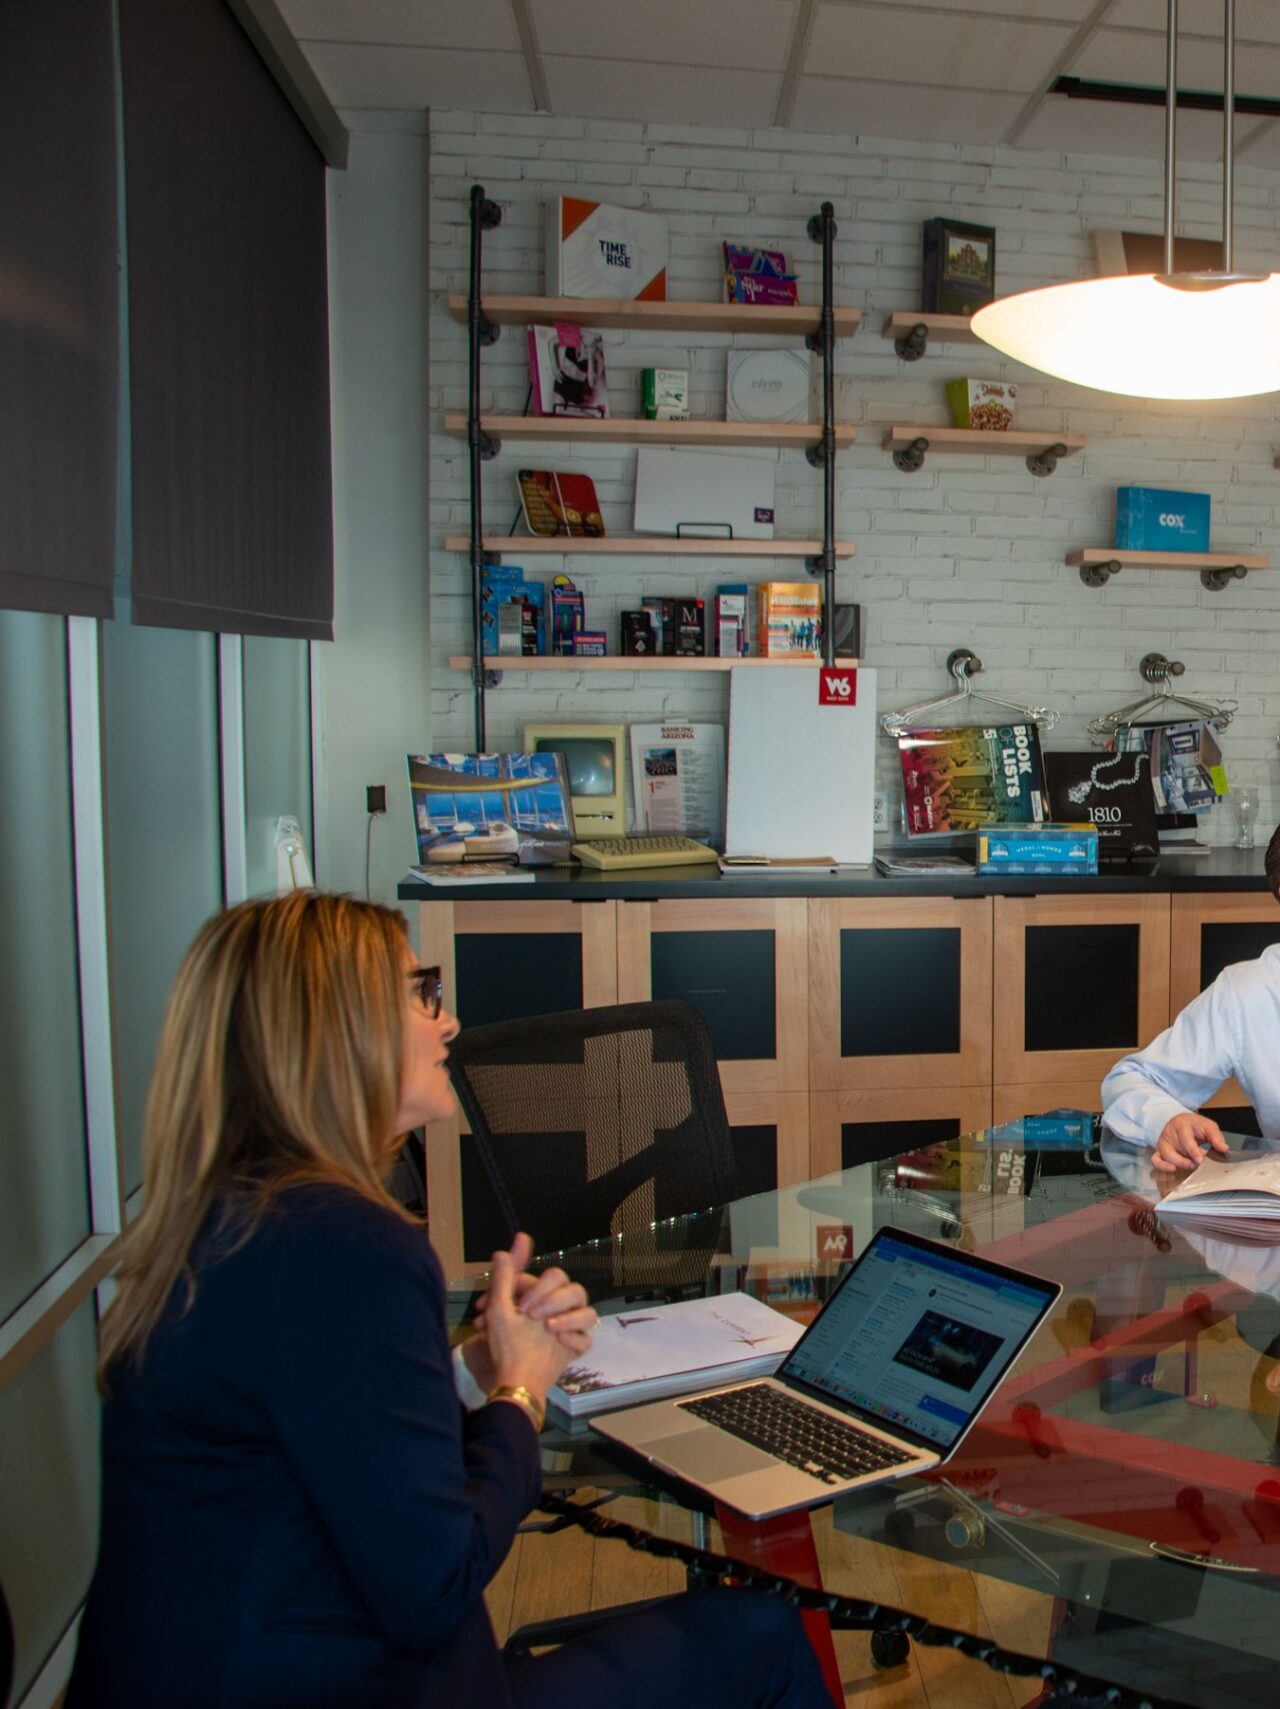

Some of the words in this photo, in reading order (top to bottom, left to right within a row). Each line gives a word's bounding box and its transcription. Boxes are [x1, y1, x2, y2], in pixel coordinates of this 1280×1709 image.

[599, 240, 626, 256] TIME
[606, 254, 631, 269] RISE
[1159, 513, 1185, 528] COX
[682, 607, 698, 622] M
[825, 676, 851, 697] W6
[999, 727, 1015, 746] OF
[1013, 725, 1032, 774] BOOK
[1002, 748, 1021, 798] LISTS
[1088, 807, 1122, 823] 1810
